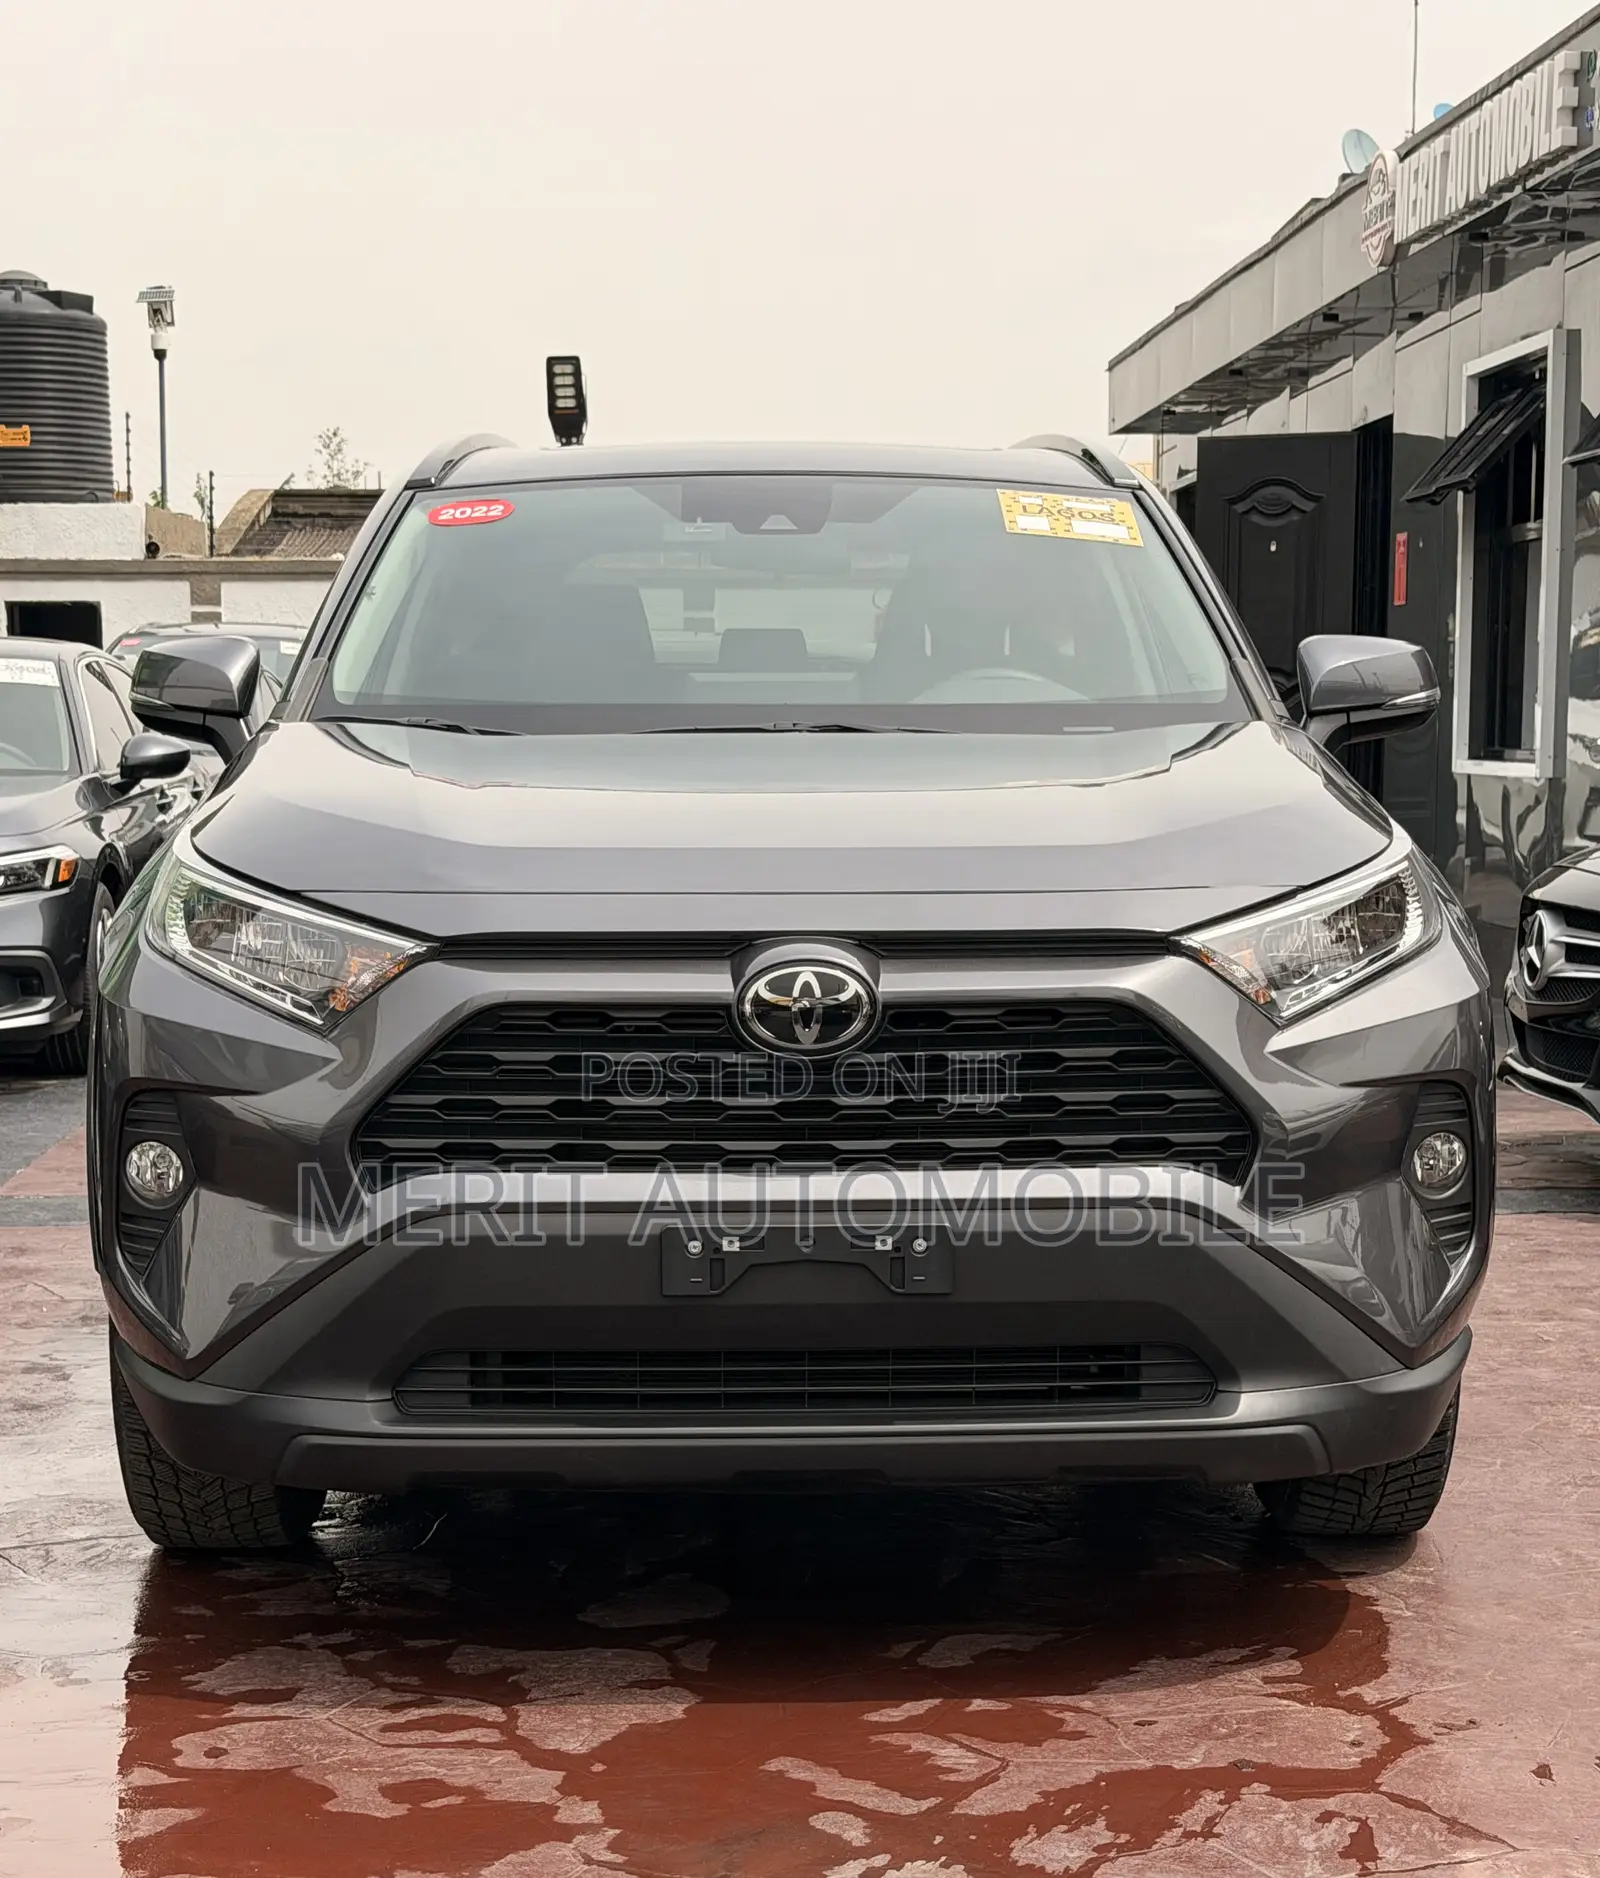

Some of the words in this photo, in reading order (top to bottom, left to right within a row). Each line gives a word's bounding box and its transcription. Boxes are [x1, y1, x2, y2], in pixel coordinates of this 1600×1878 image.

[1394, 134, 1451, 245] MERIT
[1444, 50, 1581, 217] AUTOMOBILE
[438, 504, 504, 520] 2022
[1022, 504, 1116, 523] LAGOS
